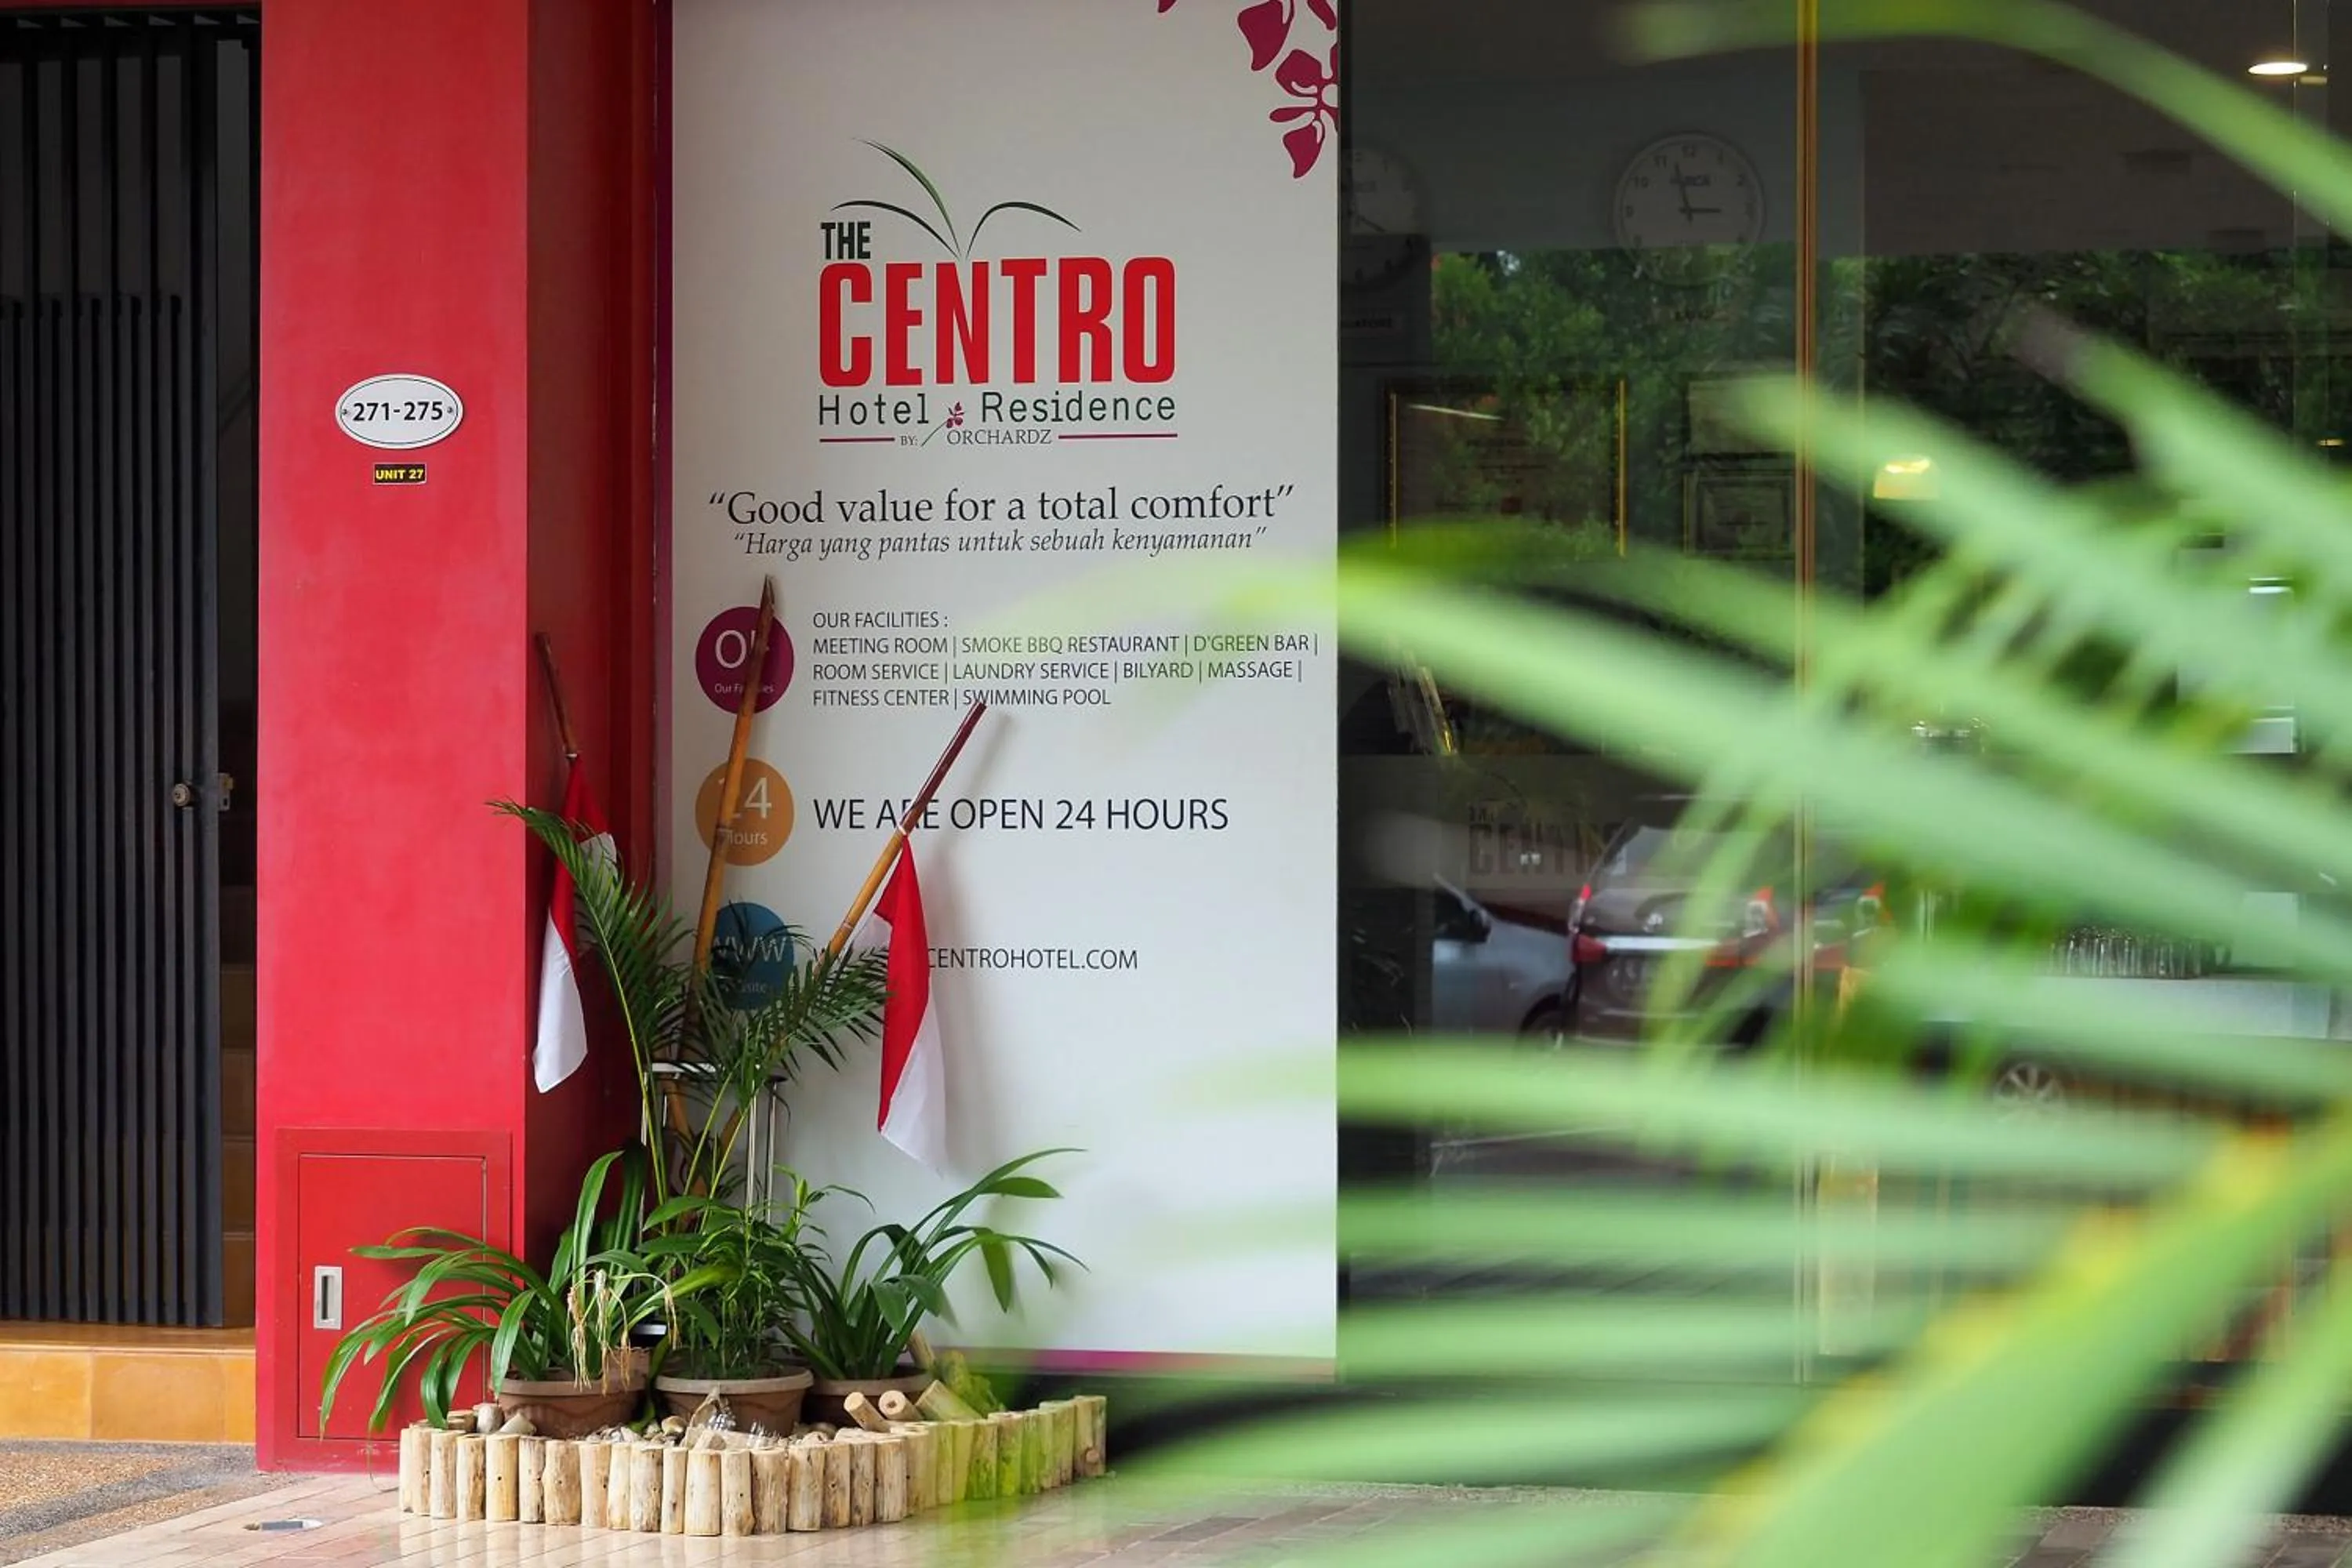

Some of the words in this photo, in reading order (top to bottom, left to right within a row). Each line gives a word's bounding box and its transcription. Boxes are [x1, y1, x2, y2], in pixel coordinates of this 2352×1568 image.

[820, 221, 870, 260] THE
[820, 256, 1174, 387] CENTRO
[353, 401, 443, 421] 271-275
[819, 393, 929, 425] Hotel
[982, 390, 1175, 423] Residence
[946, 426, 1052, 445] ORCHARDZ
[376, 470, 405, 480] UNIT
[408, 469, 424, 479] 27
[710, 490, 825, 524] “Good
[836, 489, 933, 522] value
[944, 488, 996, 521] for
[1007, 499, 1025, 521] a
[1038, 486, 1119, 521] total
[1131, 485, 1294, 519] comfort”
[819, 538, 872, 561] yang
[878, 532, 949, 560] pantas
[959, 528, 1024, 551] untuk
[1030, 528, 1104, 551] sebuah
[813, 612, 850, 628] OUR
[855, 612, 939, 627] FACILITIES
[814, 637, 888, 654] MEETING
[895, 637, 947, 653] ROOM
[962, 637, 1022, 652] SMOKE
[1028, 637, 1062, 654] BBQ
[1068, 636, 1179, 652] RESTAURANT
[1194, 635, 1269, 652] D'GREEN
[1275, 635, 1308, 651] BAR
[814, 664, 866, 680] ROOM
[872, 663, 939, 680] SERVICE
[953, 662, 1035, 679] LAUNDRY
[1040, 662, 1109, 679] SERVICE
[1123, 662, 1193, 678] BILYARD
[1208, 662, 1292, 677] MASSAGE
[814, 690, 879, 706] FITNESS
[884, 690, 949, 706] CENTER
[963, 689, 1058, 706] SWIMMING
[1063, 688, 1112, 705] POOL
[718, 777, 772, 818] 4
[813, 799, 866, 829] WE
[950, 798, 1043, 829] OPEN
[1055, 800, 1096, 829] 24
[1108, 798, 1228, 829] HOURS
